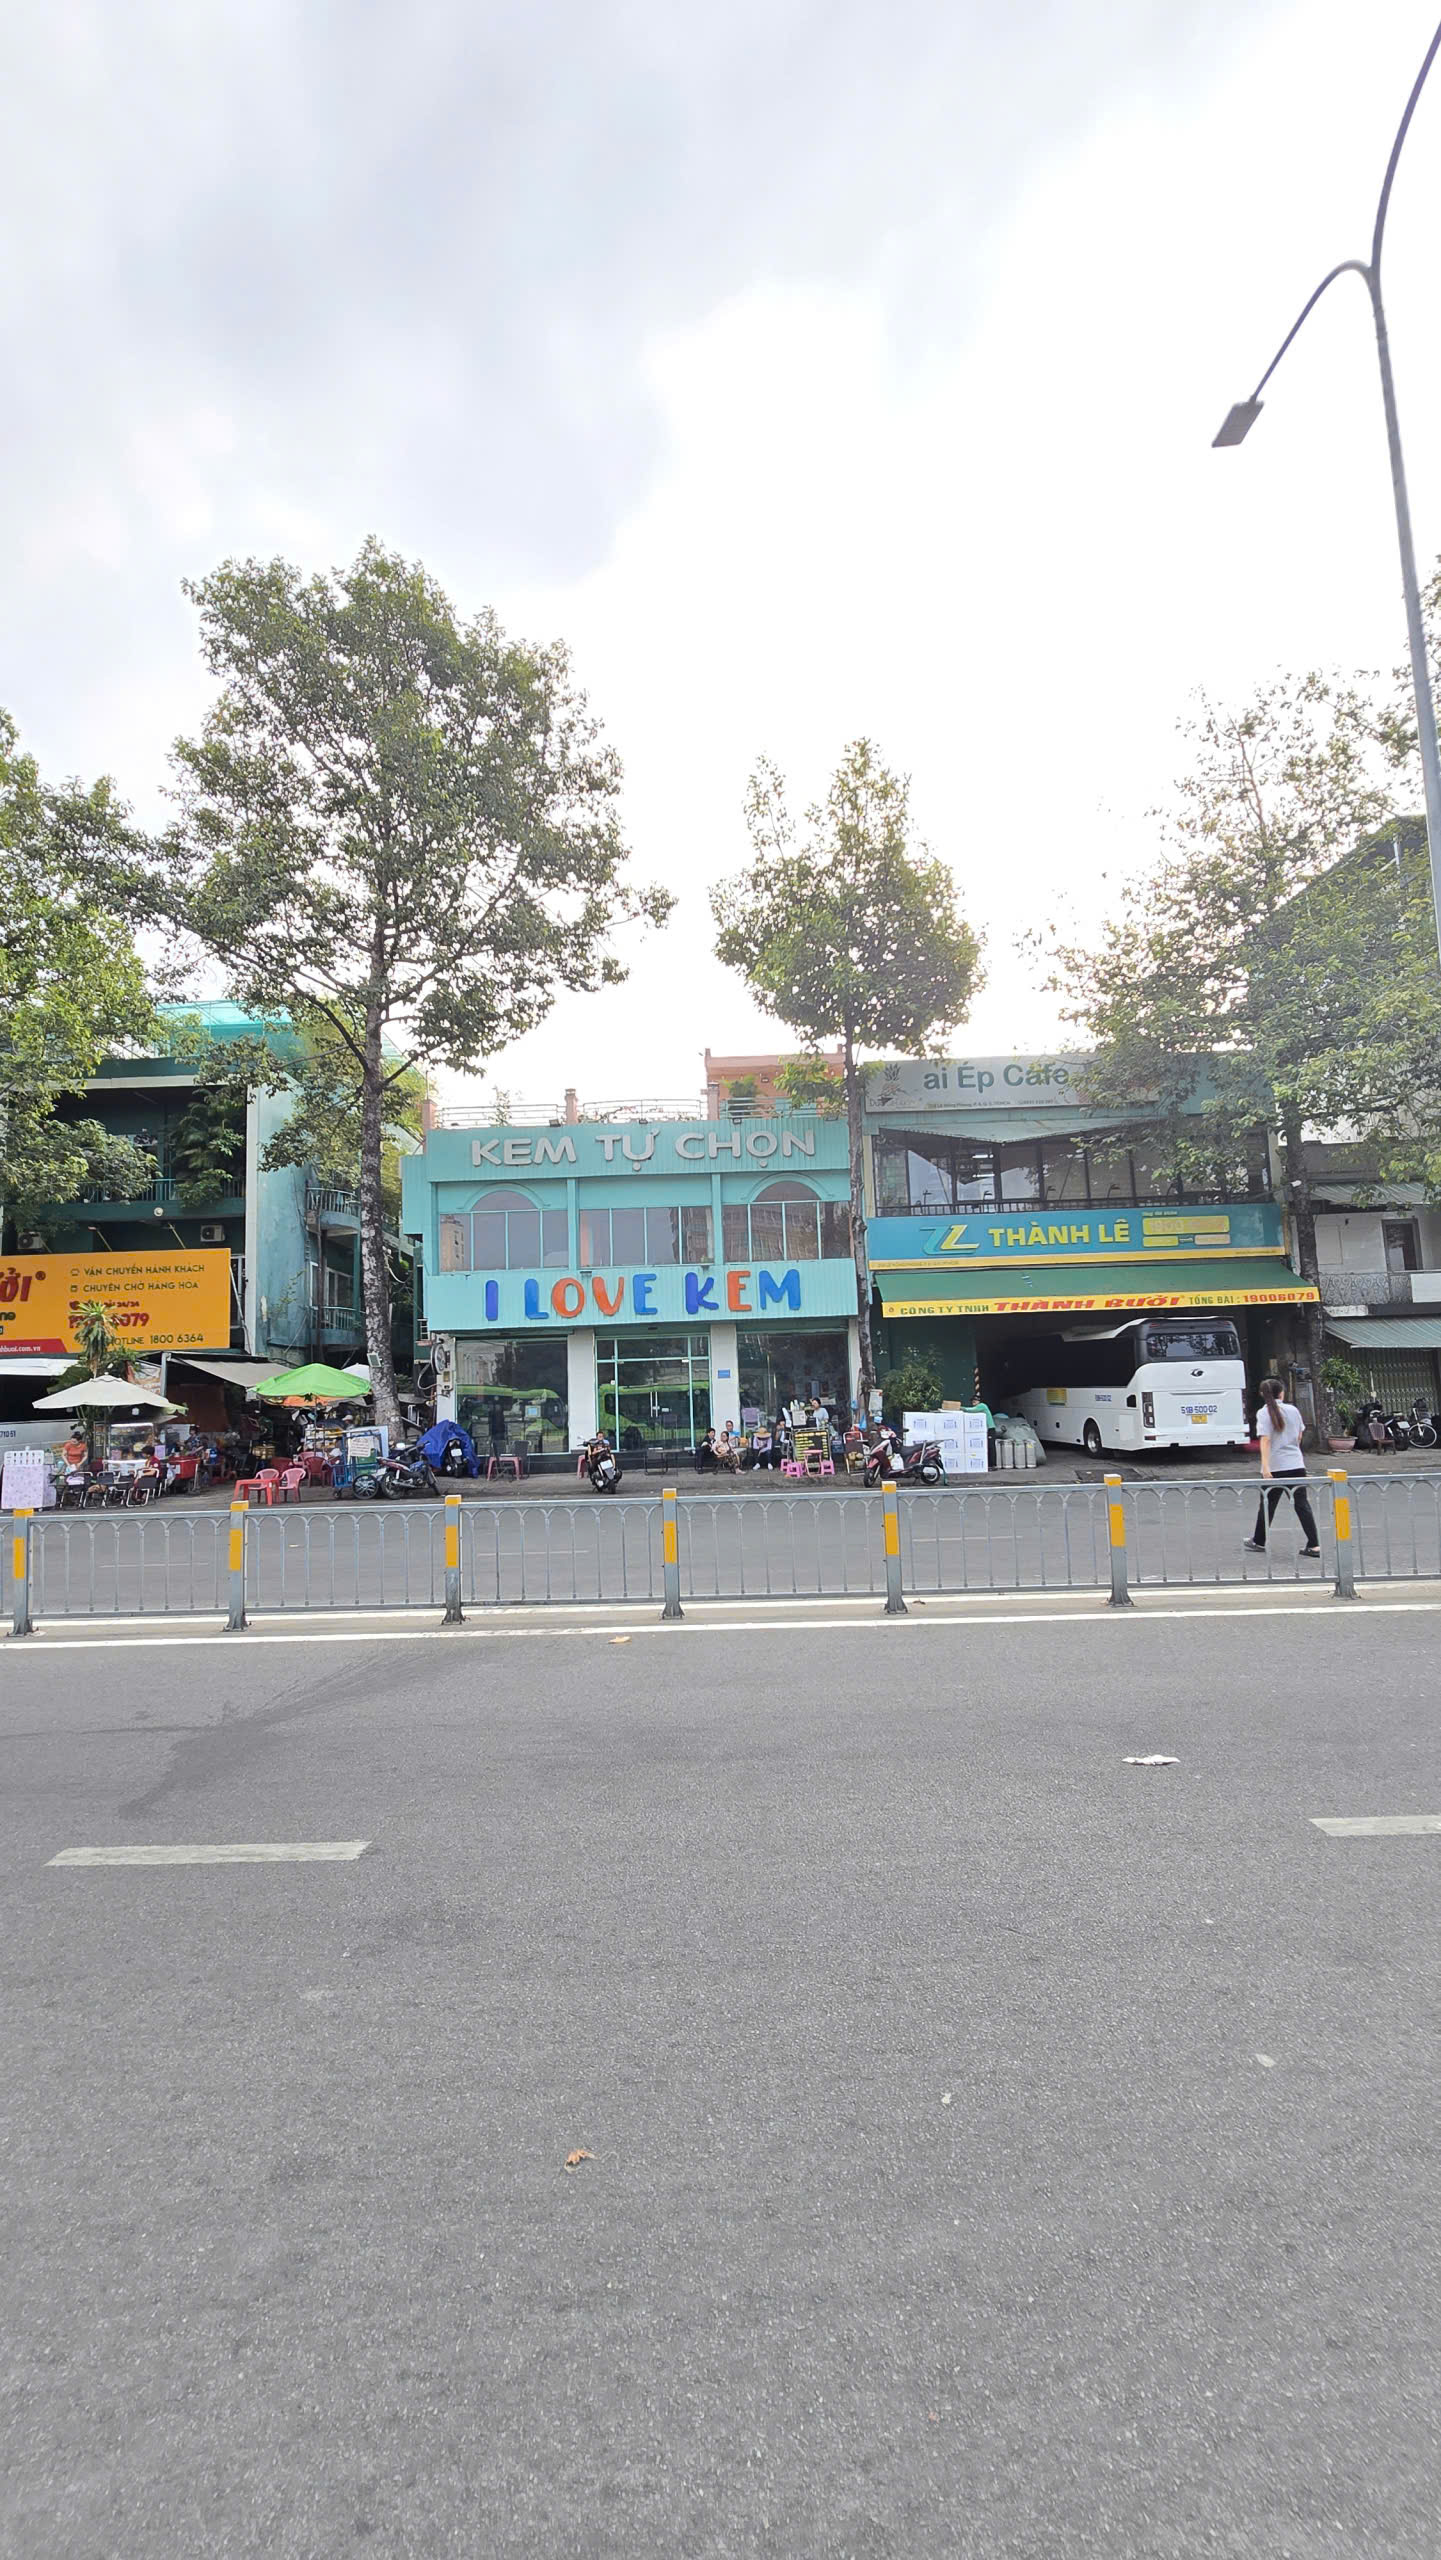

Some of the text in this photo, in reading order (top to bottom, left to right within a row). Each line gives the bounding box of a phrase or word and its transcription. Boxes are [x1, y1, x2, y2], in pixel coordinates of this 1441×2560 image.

[957, 1061, 995, 1093] Ép
[471, 1128, 816, 1171] KEM TỰ CHỌN
[987, 1221, 1091, 1247] THÀNH
[1098, 1218, 1131, 1244] LÊ
[174, 1262, 205, 1273] KHÁCH
[484, 1269, 801, 1321] I LOVE KEM
[938, 1305, 954, 1313] TY
[957, 1304, 990, 1313] TNHH
[993, 1298, 1095, 1311] THÀNH
[1104, 1294, 1181, 1308] BƯỞI
[1243, 1292, 1316, 1303] 19006079
[150, 1334, 174, 1344] 1800
[176, 1333, 204, 1343] 6364
